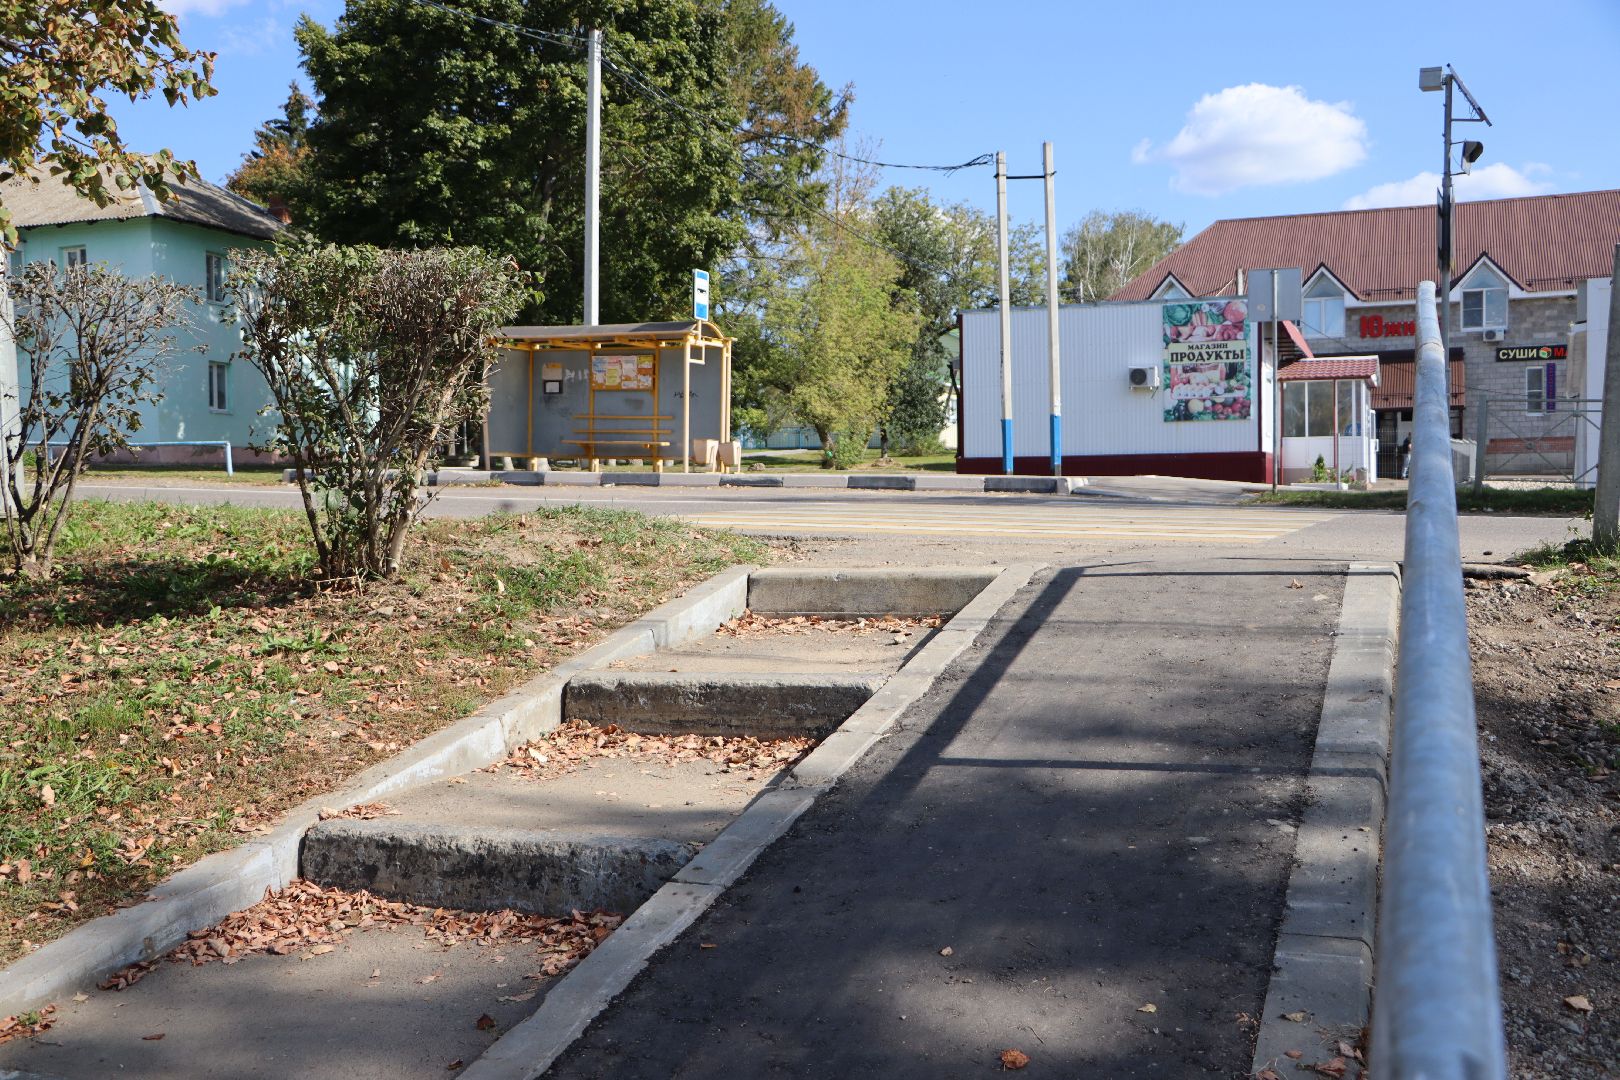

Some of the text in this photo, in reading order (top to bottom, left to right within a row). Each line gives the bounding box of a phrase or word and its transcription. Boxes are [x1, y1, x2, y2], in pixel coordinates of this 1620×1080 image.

[1187, 343, 1228, 351] МАГАЗИН
[1170, 350, 1244, 362] ПРОДУКТЫ
[1499, 348, 1537, 359] СУШИ
